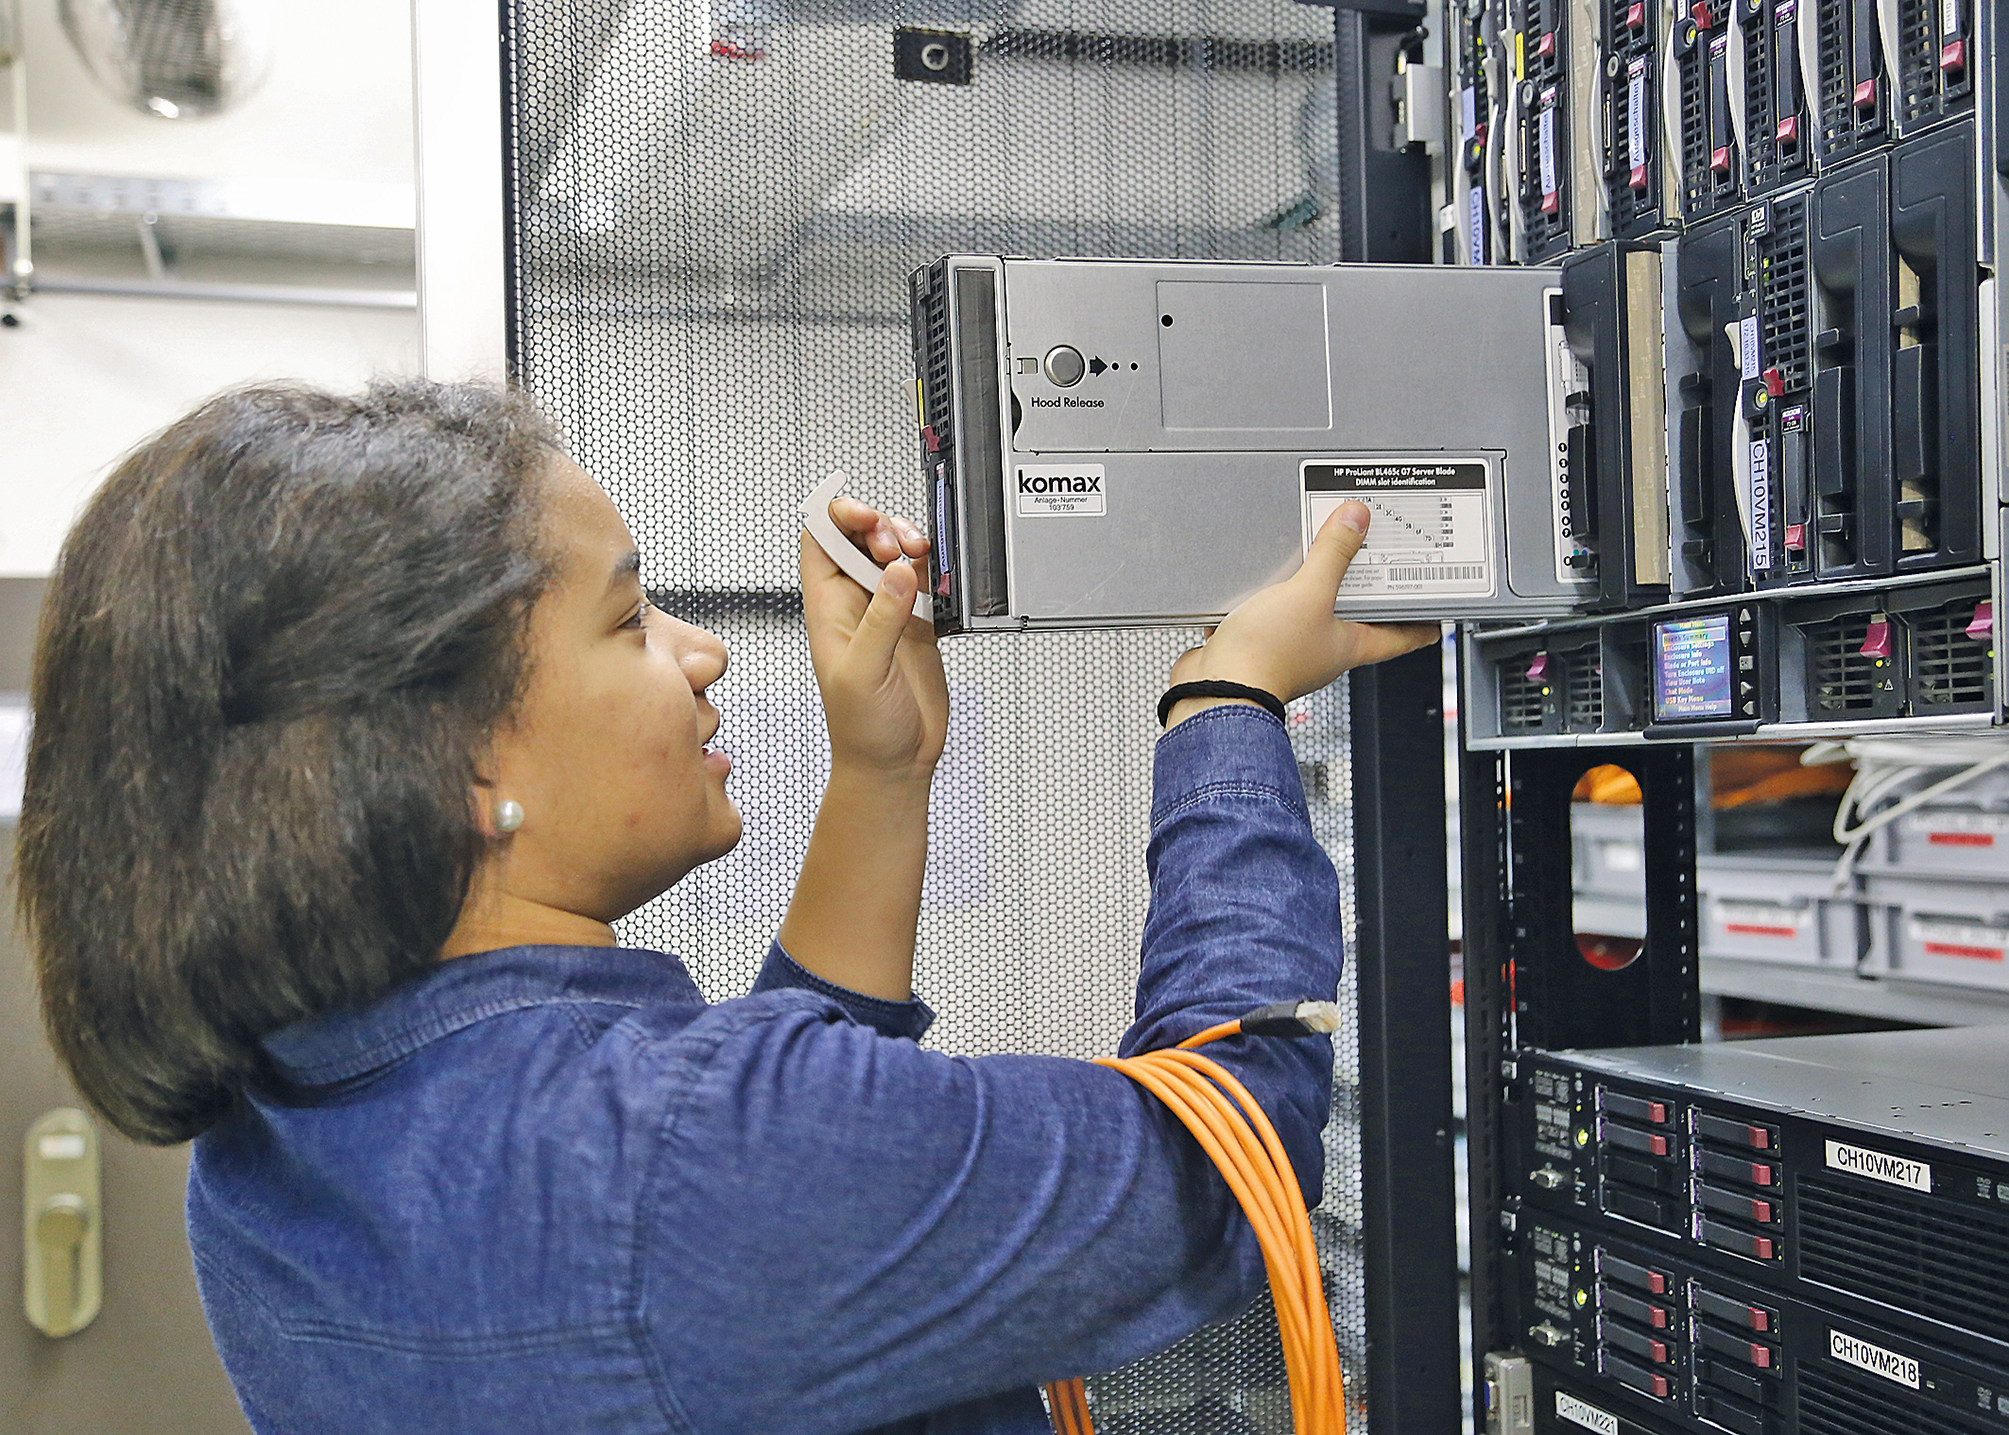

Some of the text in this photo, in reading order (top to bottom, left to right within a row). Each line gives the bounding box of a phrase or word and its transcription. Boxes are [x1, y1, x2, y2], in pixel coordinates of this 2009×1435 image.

[1031, 396, 1105, 408] Hood Release
[1334, 468, 1344, 476] HP
[1345, 467, 1374, 476] ProLiant
[1375, 466, 1400, 476] BL465c
[1412, 467, 1434, 476] Server
[1436, 466, 1456, 476] Blade
[1018, 469, 1101, 493] komax
[1355, 477, 1436, 487] DIMM slot identification
[1752, 443, 1767, 566] CH10VM215
[1664, 652, 1690, 660] Enclosure
[1688, 660, 1699, 668] Port
[1701, 658, 1712, 666] Info
[1678, 668, 1704, 676] Enclosure
[1837, 1146, 1921, 1184] CH10VM217
[1832, 1334, 1917, 1383] CH10VM218
